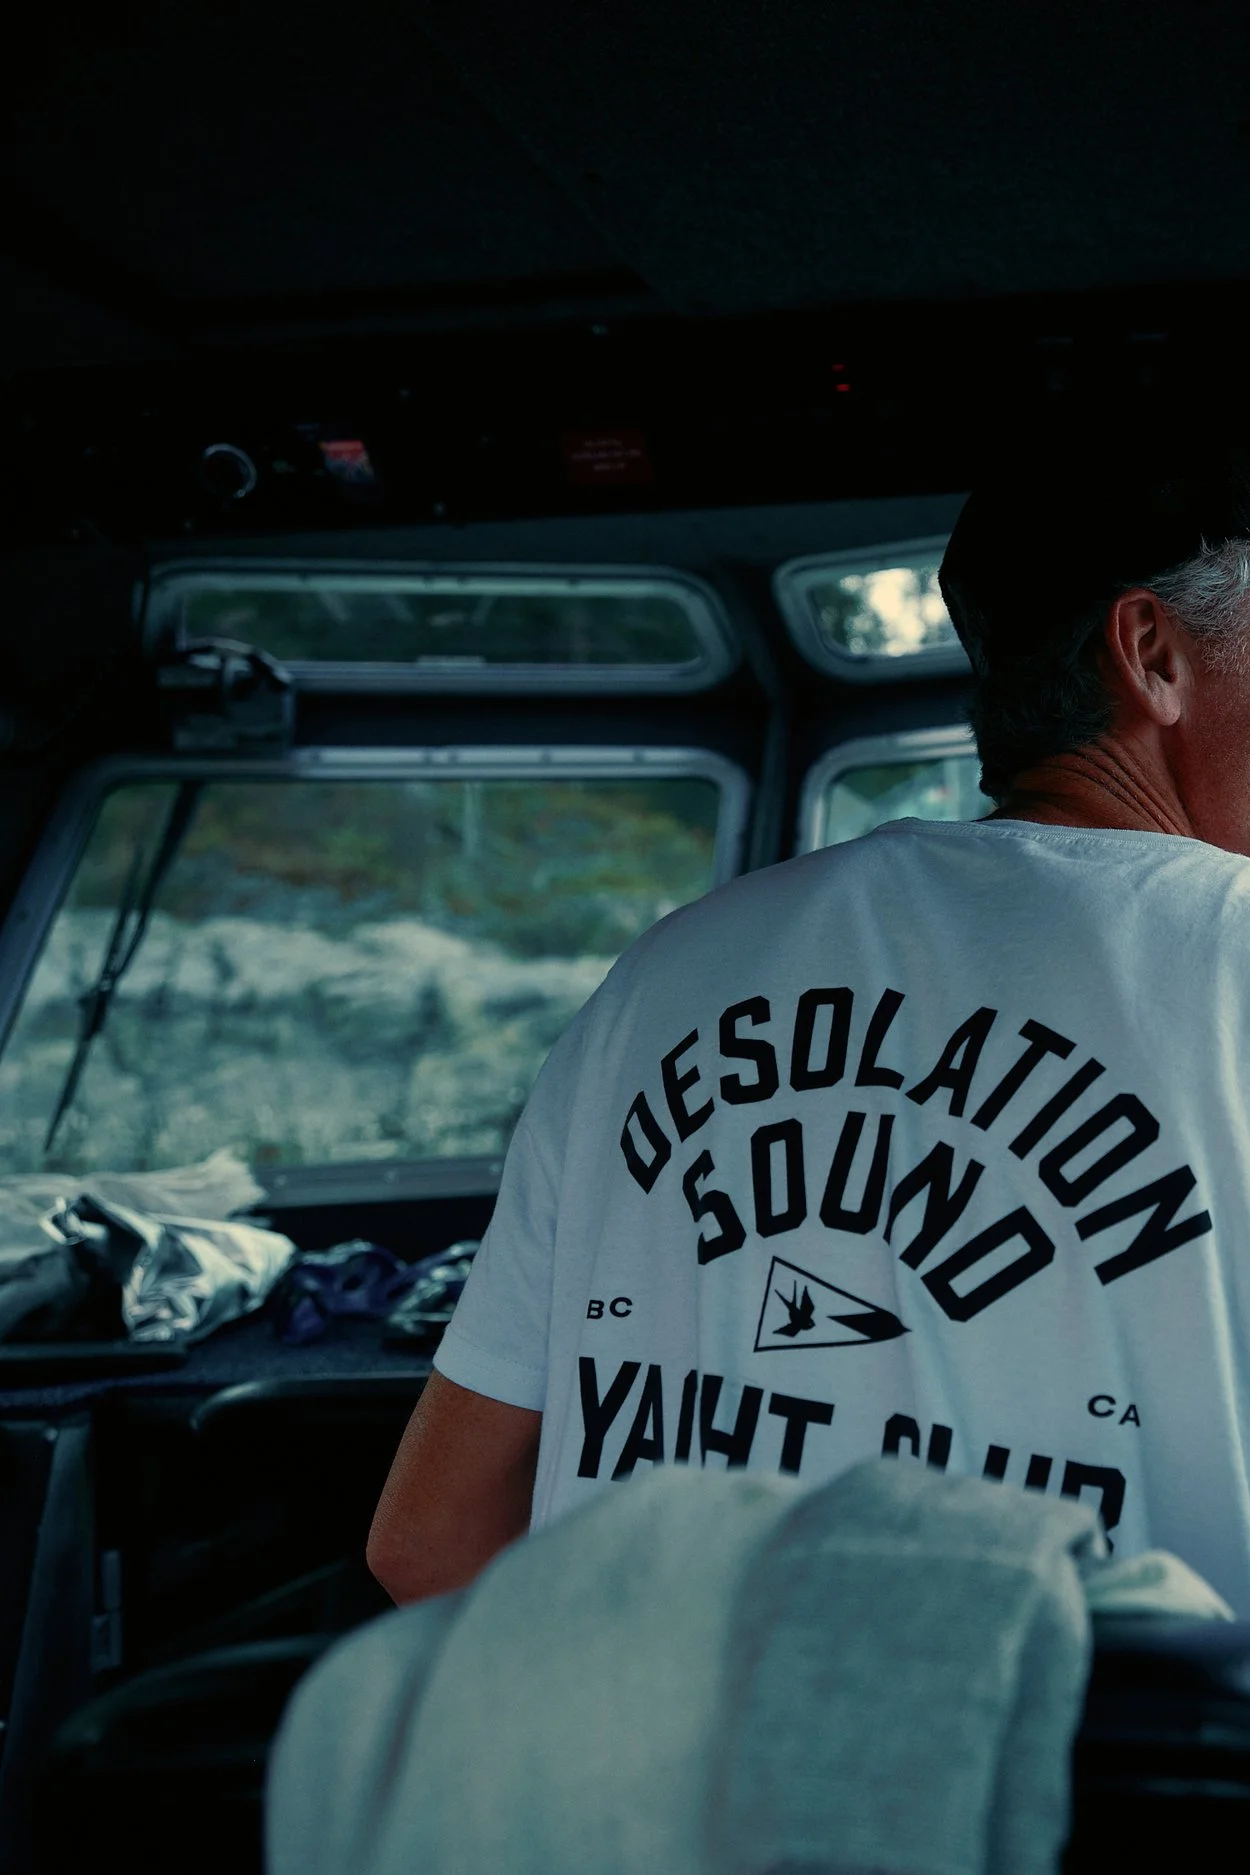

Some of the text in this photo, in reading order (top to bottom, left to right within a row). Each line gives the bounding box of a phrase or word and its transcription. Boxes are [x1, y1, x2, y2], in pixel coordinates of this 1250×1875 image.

[619, 986, 1213, 1287] DESOLATION
[681, 1110, 1057, 1323] SOUND
[586, 1296, 633, 1320] BC
[1087, 1394, 1141, 1428] CA
